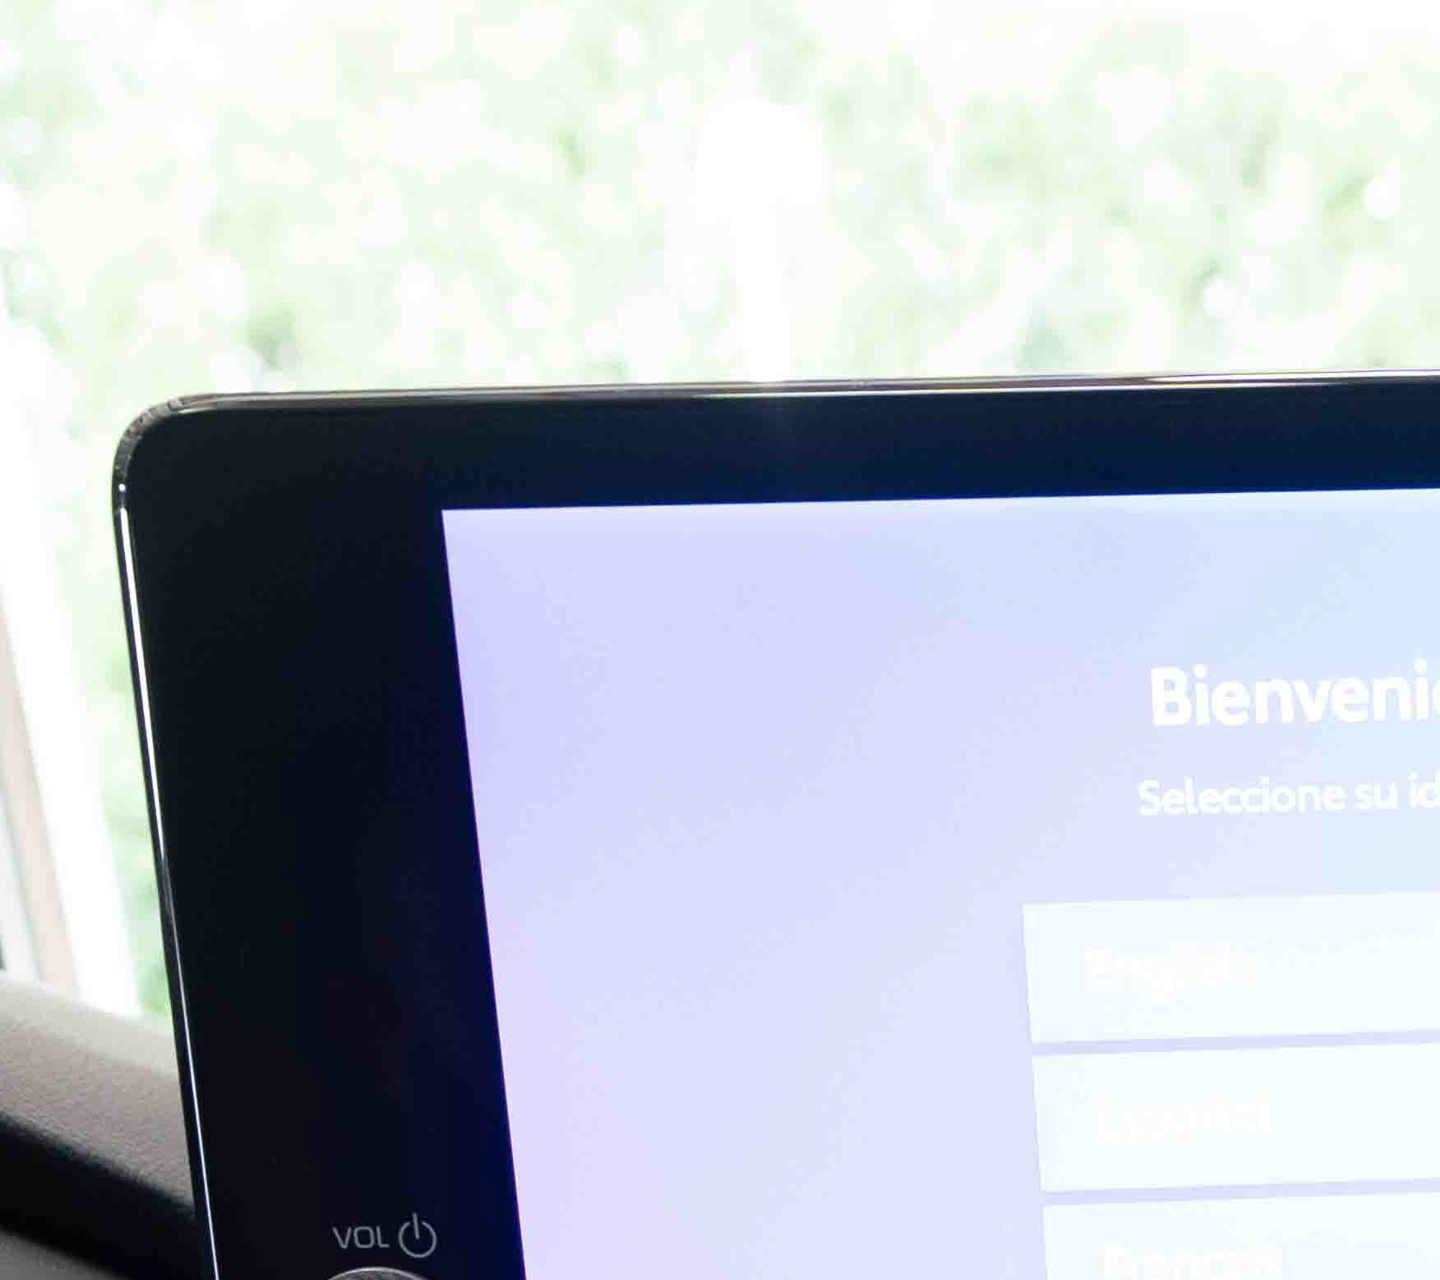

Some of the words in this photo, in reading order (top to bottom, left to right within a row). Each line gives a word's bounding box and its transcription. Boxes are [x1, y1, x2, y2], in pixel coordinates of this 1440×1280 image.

[1137, 777, 1346, 817] Seleccione
[1355, 781, 1399, 811] su
[333, 1225, 390, 1250] VOL
